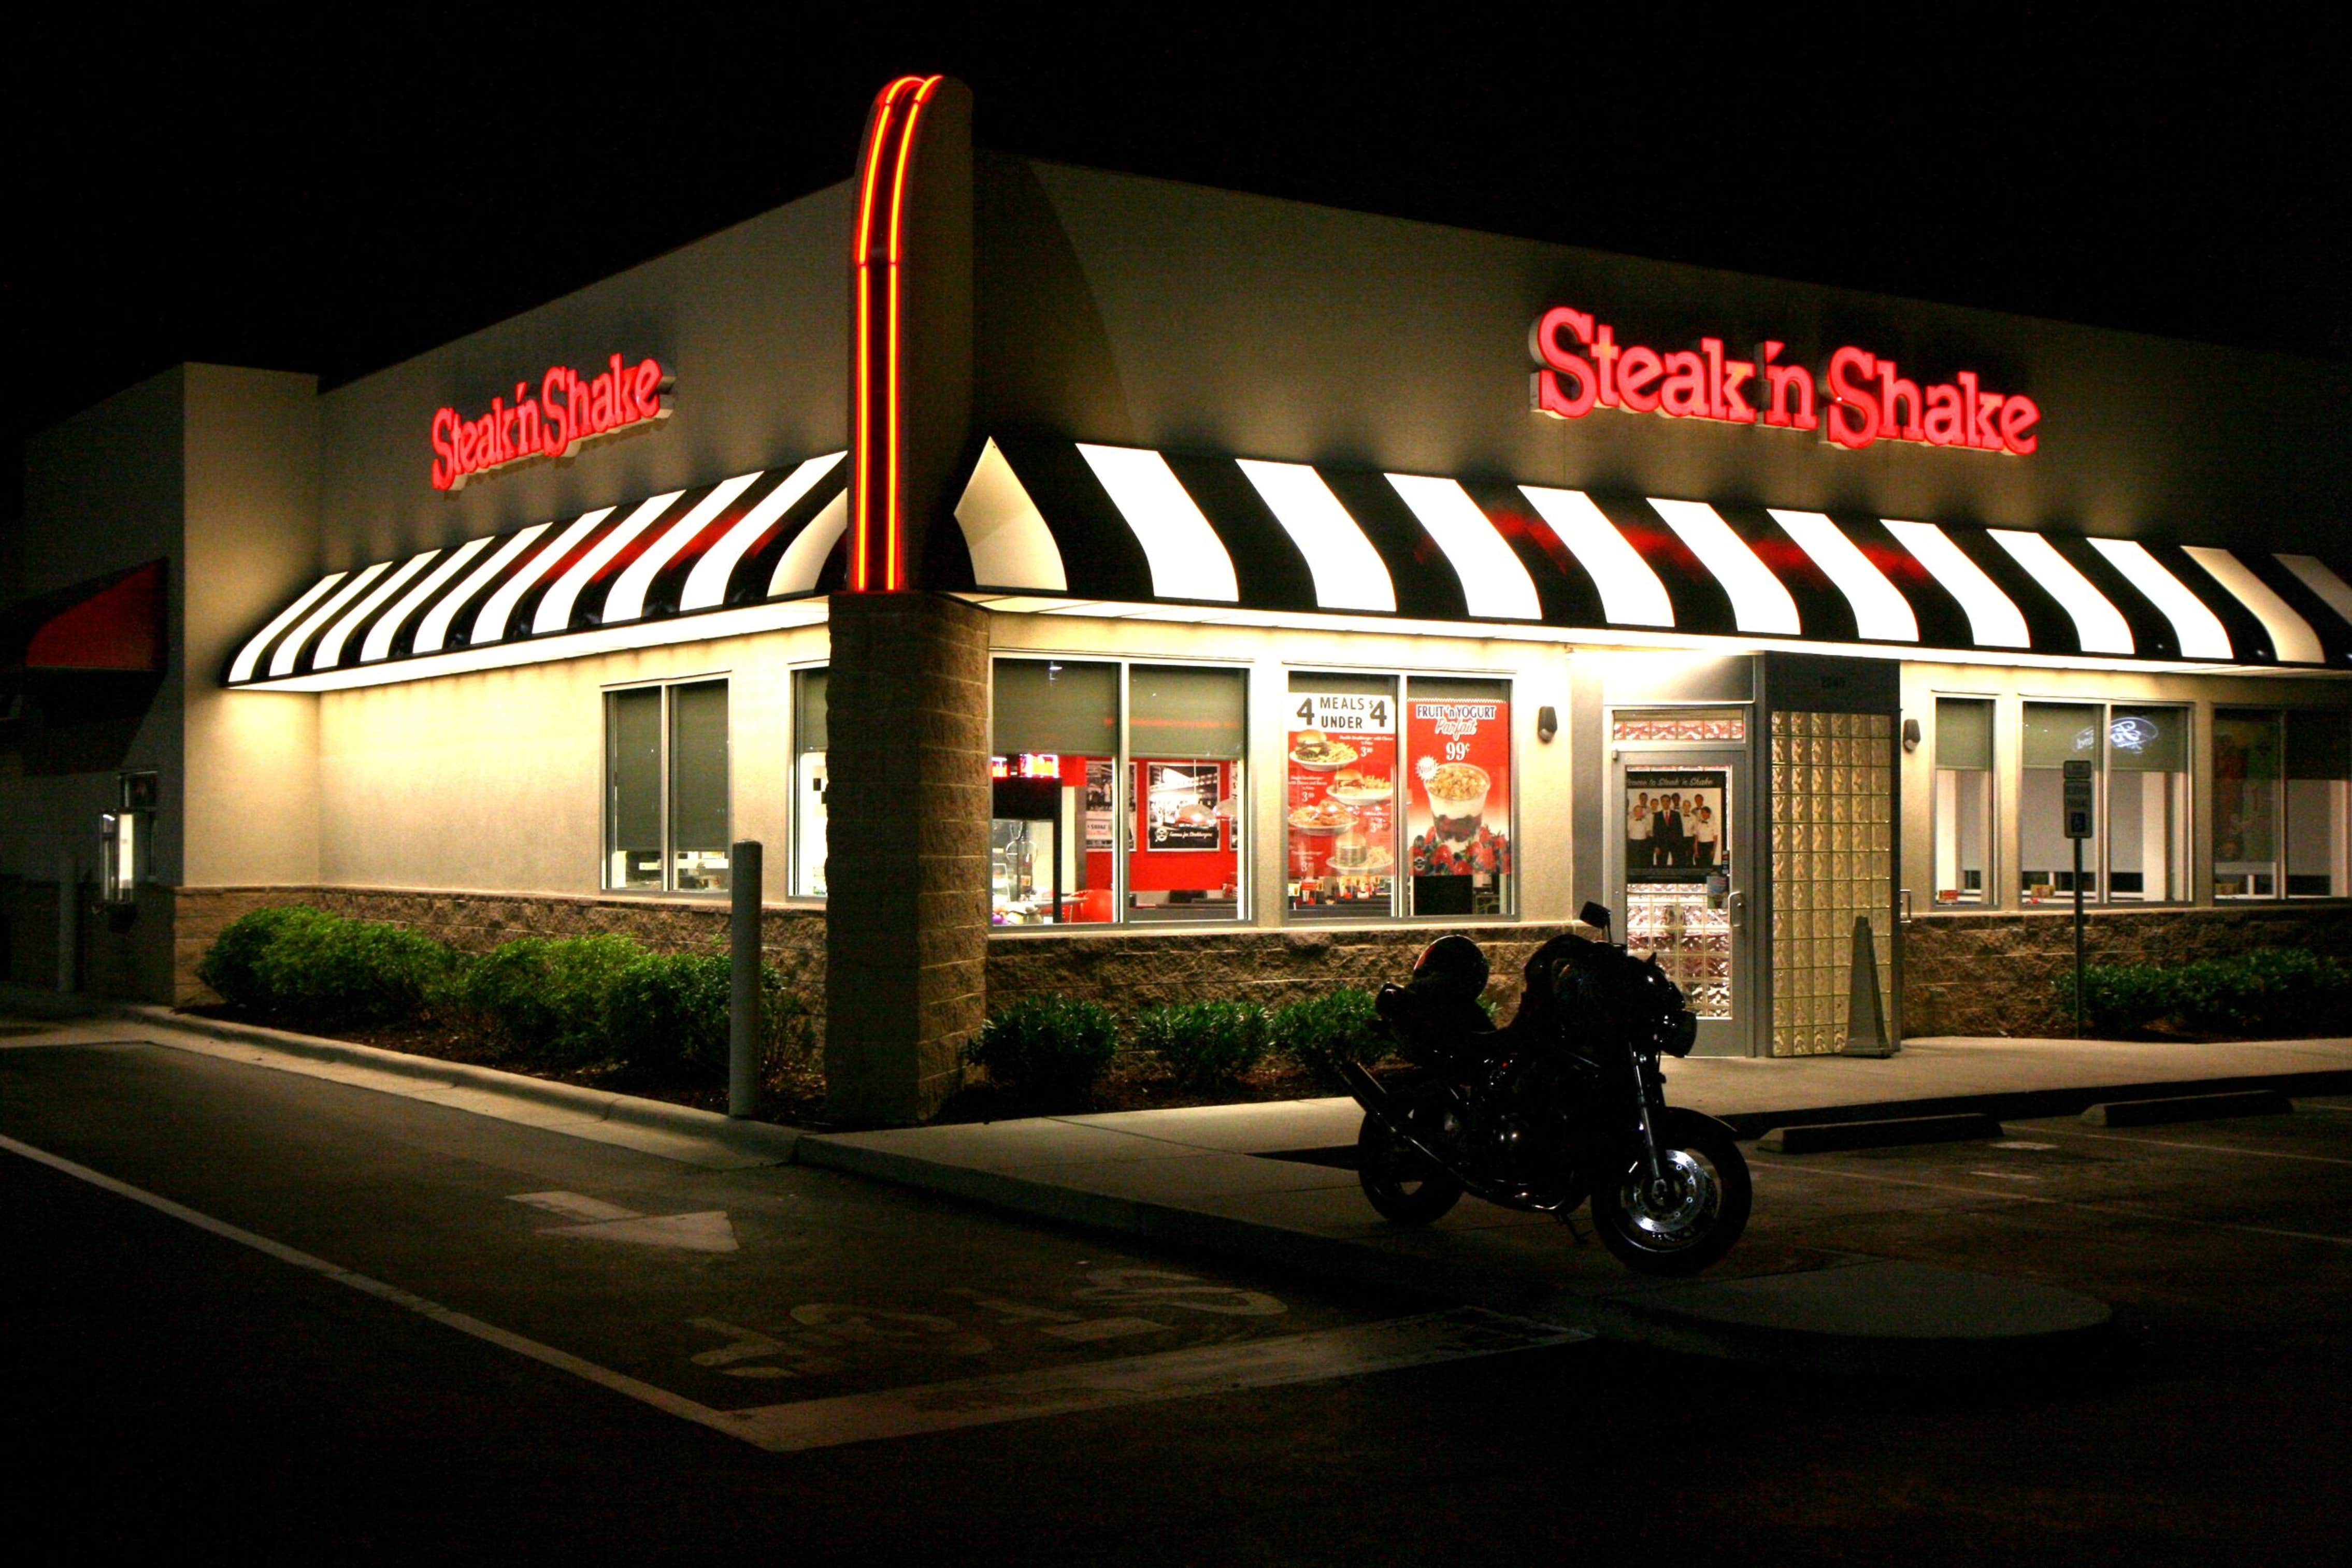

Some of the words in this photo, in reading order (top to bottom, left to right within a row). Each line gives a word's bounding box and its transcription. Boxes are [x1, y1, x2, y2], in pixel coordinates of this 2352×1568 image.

[1537, 306, 1757, 424] Steak
[1827, 346, 2041, 456] Shake
[431, 396, 518, 491] Steak
[541, 352, 663, 457] Shake
[1296, 697, 1315, 726] 4
[1320, 697, 1365, 711] MEALS
[1321, 715, 1363, 729] UNDER
[1416, 705, 1444, 717] FRUIT
[1456, 706, 1496, 718] YOGURT
[1435, 718, 1478, 741] Parfait
